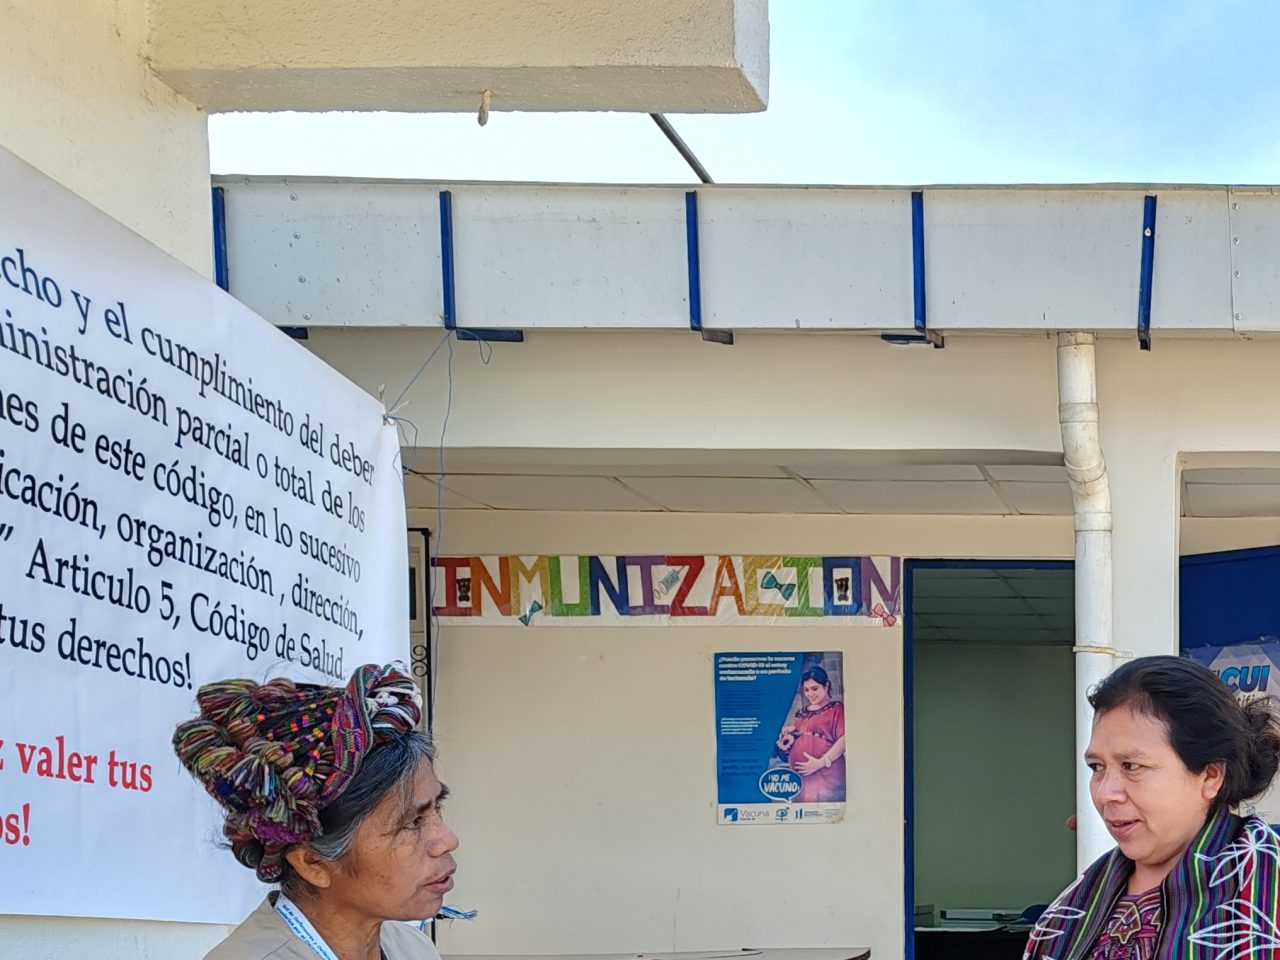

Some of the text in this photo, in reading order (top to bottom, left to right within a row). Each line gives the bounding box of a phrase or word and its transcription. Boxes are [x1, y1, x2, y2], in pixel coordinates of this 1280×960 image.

[0, 309, 365, 533] inistración parcial o total de los
[71, 290, 91, 335] y
[104, 301, 133, 345] el
[141, 327, 293, 437] cumplimiento
[300, 413, 324, 458] del
[330, 433, 374, 486] deber
[51, 402, 86, 453] de
[95, 434, 146, 481] este
[153, 459, 238, 529] código,
[245, 505, 268, 538] en
[273, 507, 293, 548] lo
[300, 531, 361, 582] sucesivo
[25, 538, 150, 613] Articulo
[160, 580, 180, 630] 5,
[190, 592, 270, 661] Código
[275, 623, 297, 662] de
[117, 513, 274, 597] organización
[292, 573, 363, 641] dirección,
[432, 555, 901, 617] INMUNIZACION
[58, 618, 192, 690] derechos!
[1220, 665, 1270, 693] CUI
[15, 735, 98, 784] valer
[108, 750, 153, 792] tus
[740, 809, 770, 818] Vacuna
